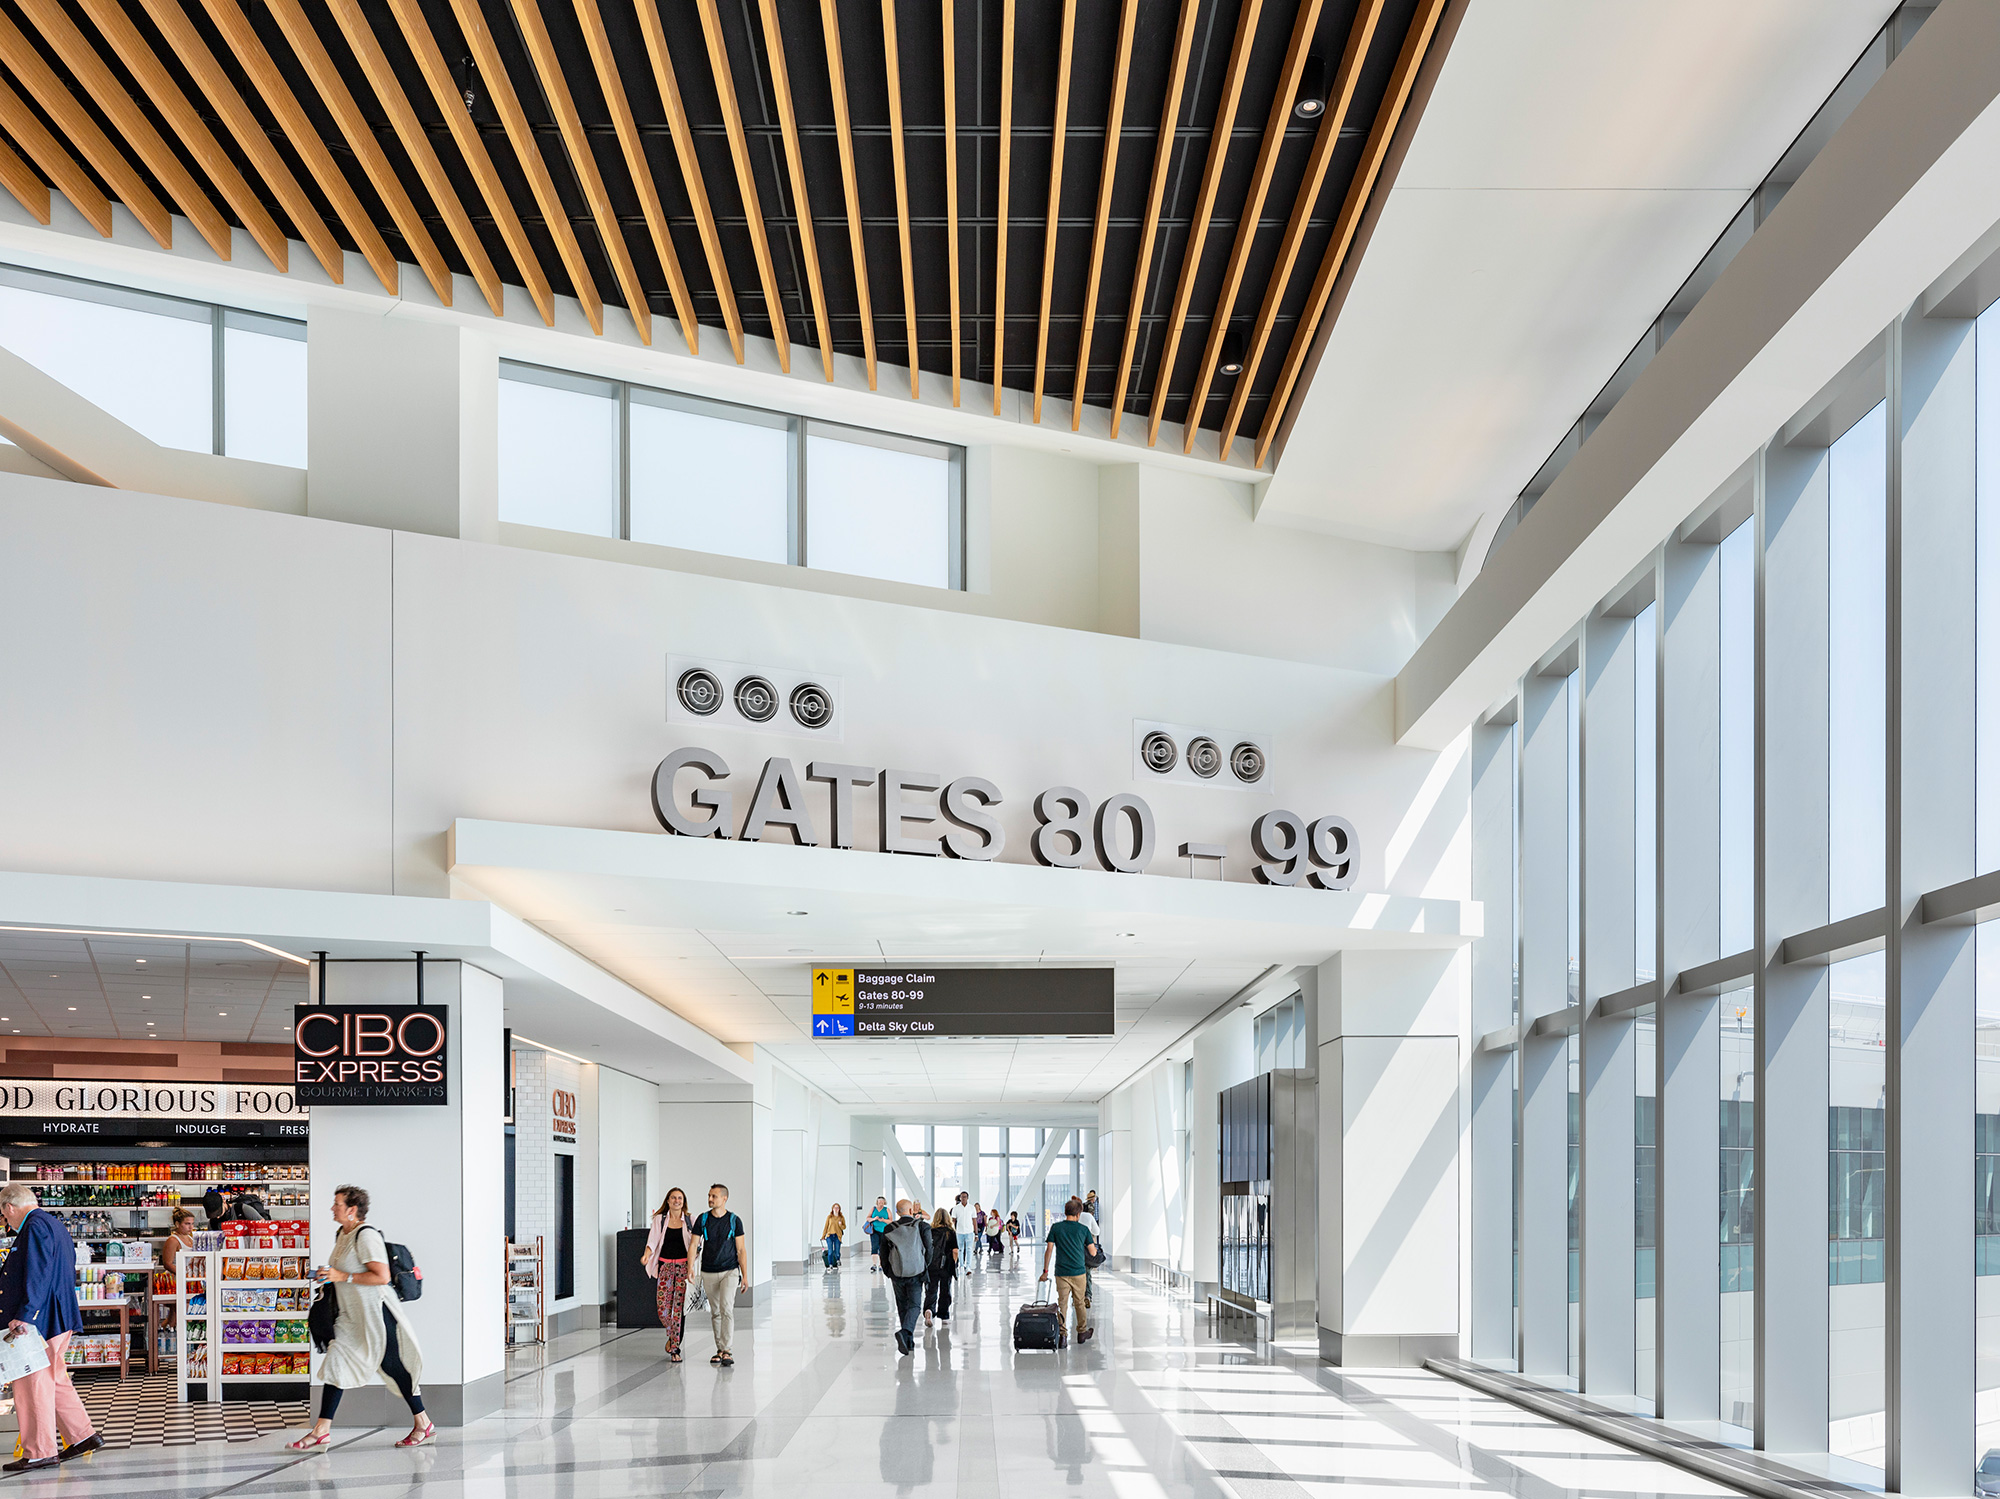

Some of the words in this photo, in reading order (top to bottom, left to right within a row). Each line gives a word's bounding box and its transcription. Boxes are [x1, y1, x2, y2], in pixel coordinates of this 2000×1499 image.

[651, 746, 1006, 861] GATES
[1030, 786, 1156, 873] 80
[1251, 809, 1361, 891] 99
[858, 974, 904, 985] Baggage
[906, 974, 935, 983] Claim
[858, 990, 889, 1000] Gates
[891, 990, 924, 1000] 80-99
[858, 1002, 875, 1010] 9-13
[875, 1002, 904, 1010] minutes
[858, 1022, 886, 1031] Delta
[888, 1022, 908, 1033] Sky
[910, 1022, 935, 1031] Club
[295, 1012, 445, 1057] CIBO
[300, 1086, 373, 1098] GOURMET
[375, 1086, 444, 1098] MARKETS
[55, 1087, 216, 1112] GLORIOUS
[553, 1089, 576, 1119] CIBO
[43, 1122, 100, 1133] HYDRATE
[175, 1124, 227, 1134] INDULGE
